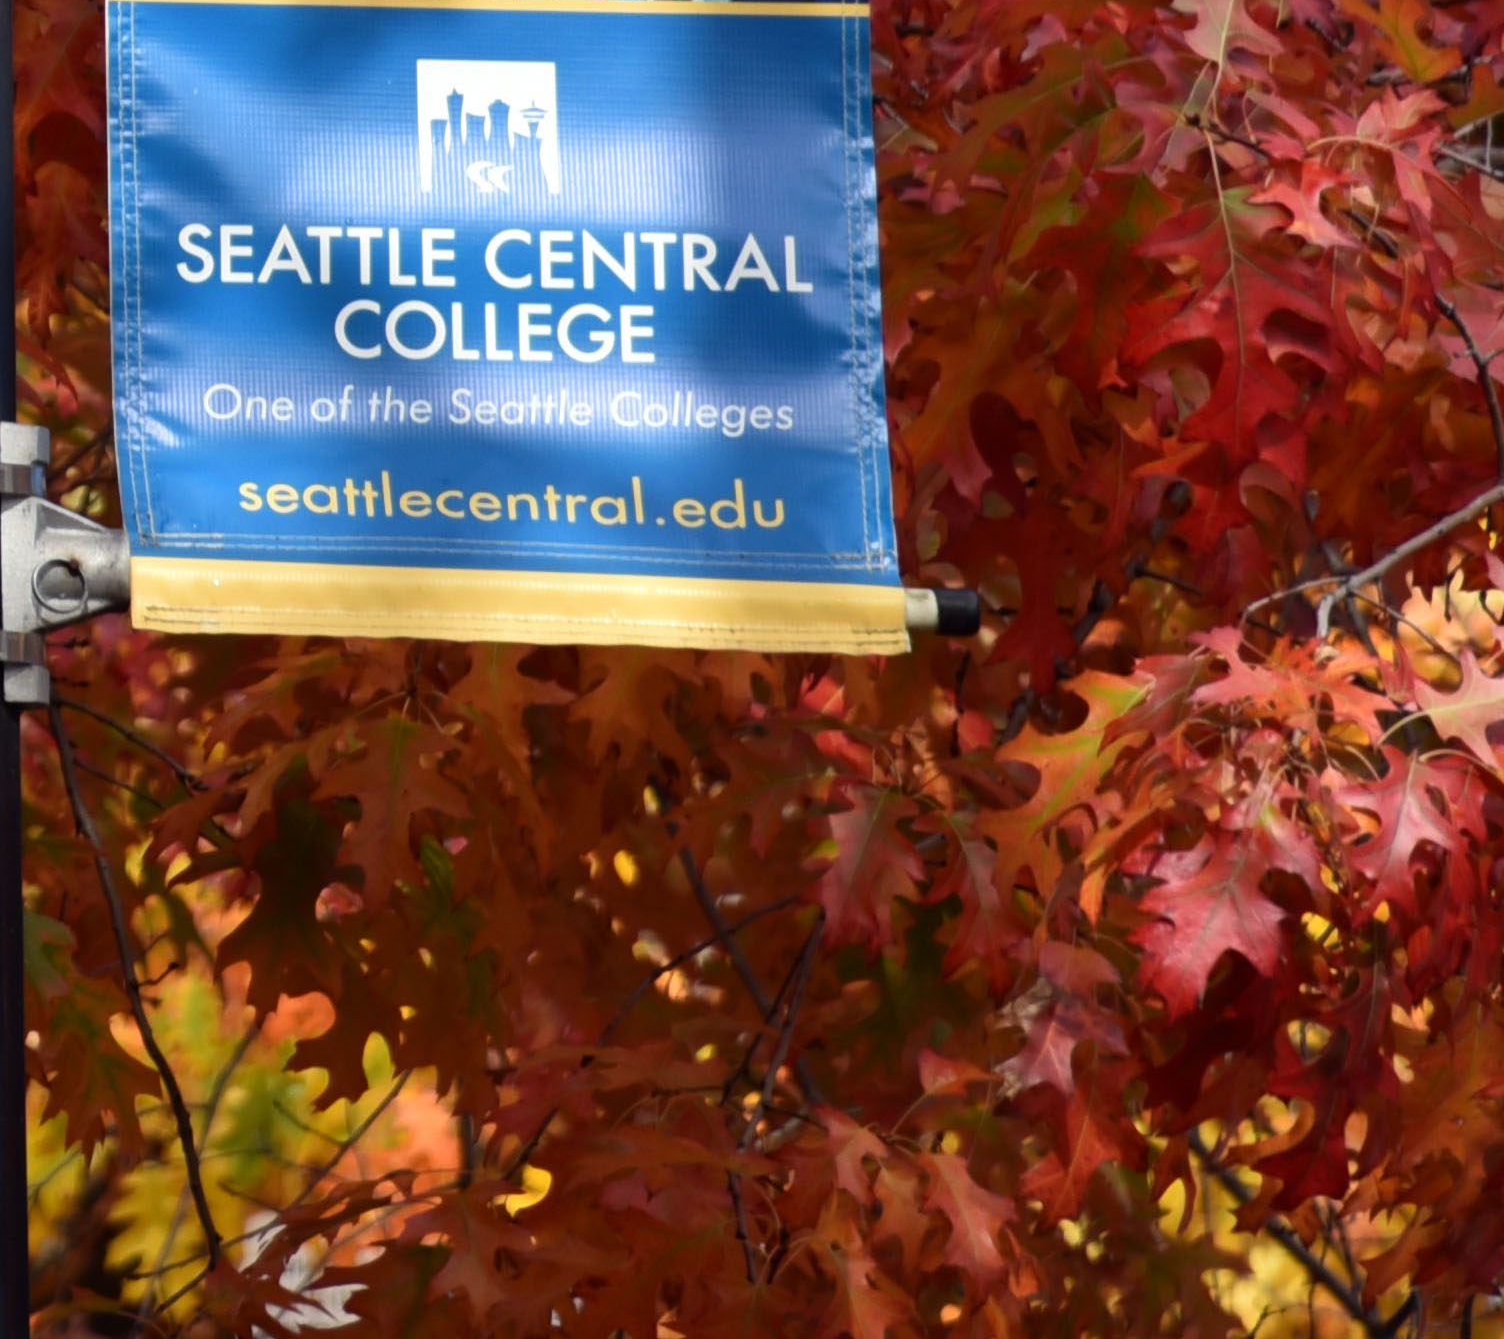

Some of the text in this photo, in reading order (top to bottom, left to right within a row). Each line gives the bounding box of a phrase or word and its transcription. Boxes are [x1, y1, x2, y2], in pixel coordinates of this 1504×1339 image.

[176, 223, 813, 294] SEATTLE CENTRAL
[334, 299, 656, 365] COLLEGE
[203, 383, 793, 437] One of the Seattle Colleges
[240, 470, 785, 529] seattlecentral.edu
